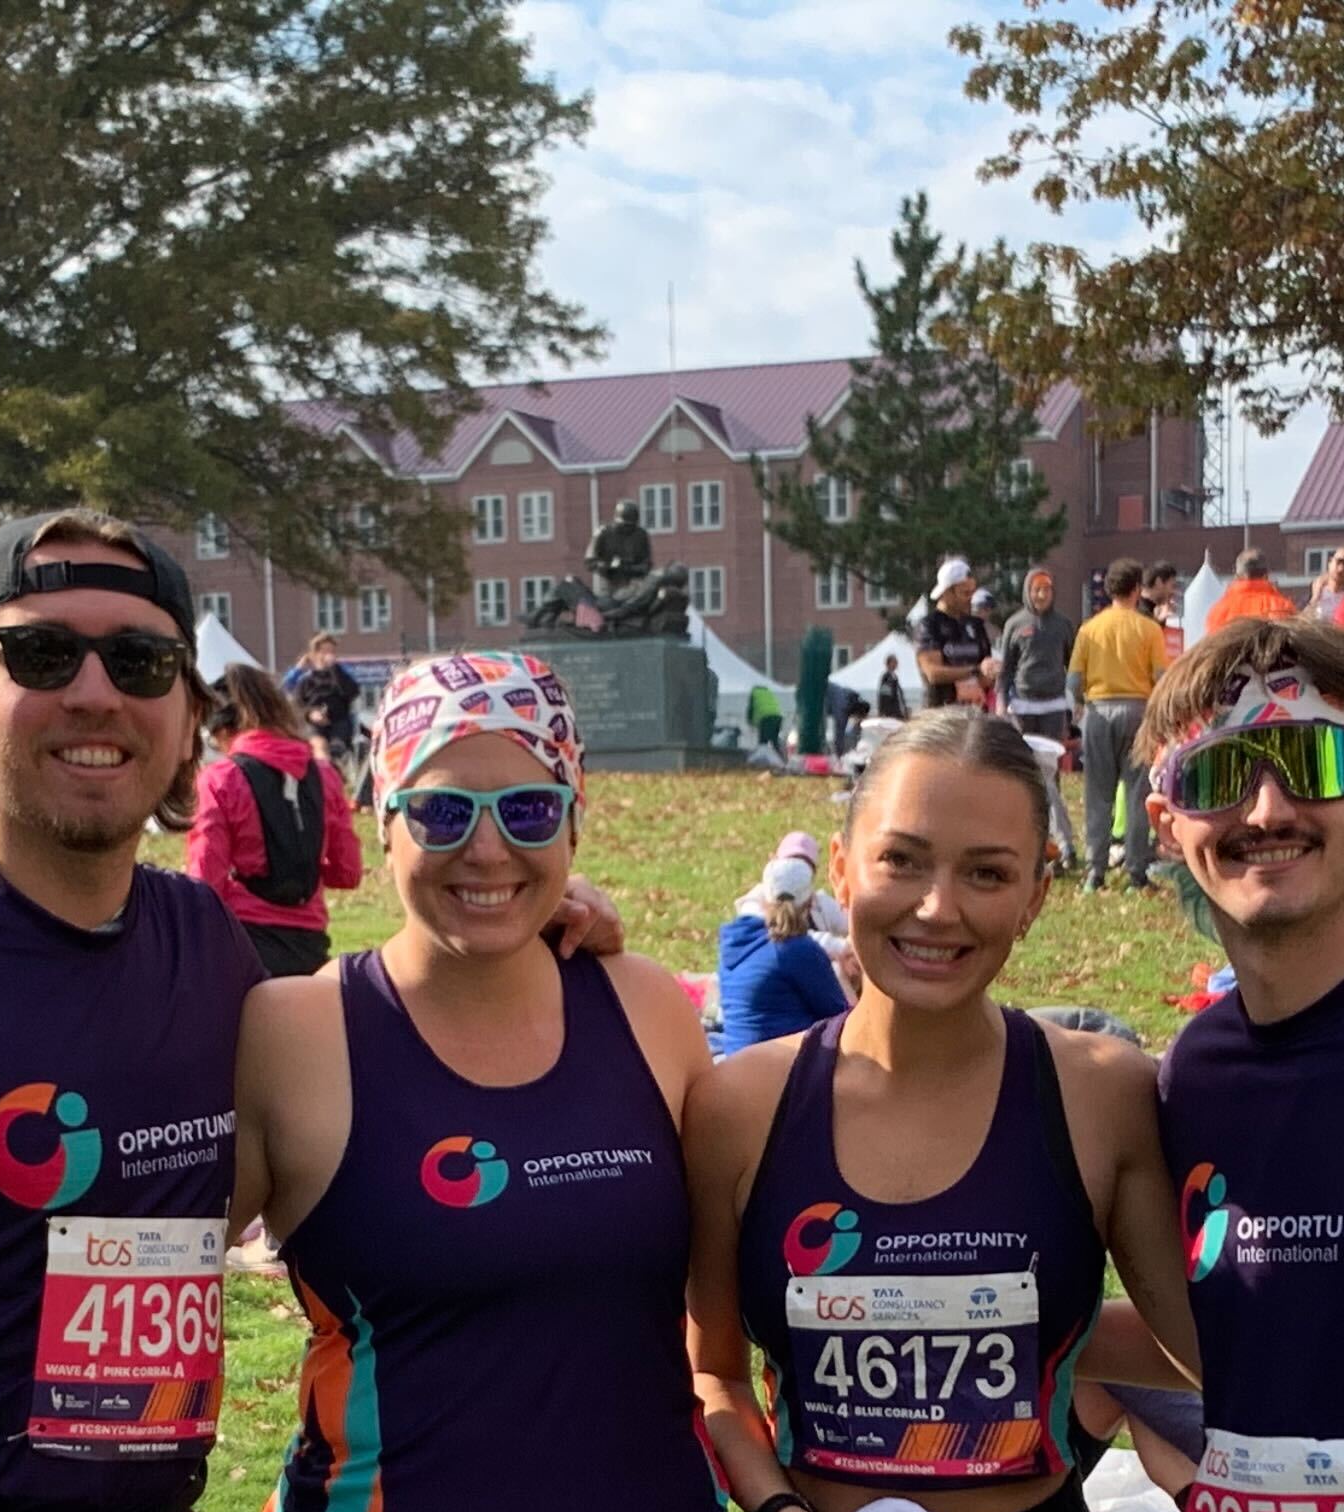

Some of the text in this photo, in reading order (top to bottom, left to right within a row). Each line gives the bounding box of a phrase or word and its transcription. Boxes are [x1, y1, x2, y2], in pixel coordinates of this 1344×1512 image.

[388, 700, 436, 730] TEAM
[122, 1144, 218, 1179] International
[524, 1149, 652, 1174] OPPORTUNITY
[528, 1165, 623, 1188] International
[137, 1232, 162, 1242] TATA
[876, 1231, 1028, 1250] OPPORTUNITY
[86, 1232, 132, 1266] tcs
[874, 1249, 978, 1264] International
[1237, 1244, 1338, 1264] International
[873, 1288, 904, 1298] TATA
[817, 1291, 865, 1321] tcs
[872, 1299, 946, 1310] CONSULTANCY
[966, 1308, 1002, 1320] TATA
[63, 1281, 221, 1357] 41369
[45, 1362, 184, 1379] WAVE 4 PINK CORRAL A
[813, 1332, 1016, 1400] 46173
[805, 1402, 945, 1421] WAVE 4 BLUE CORRAL D
[1305, 1474, 1338, 1485] TATA
